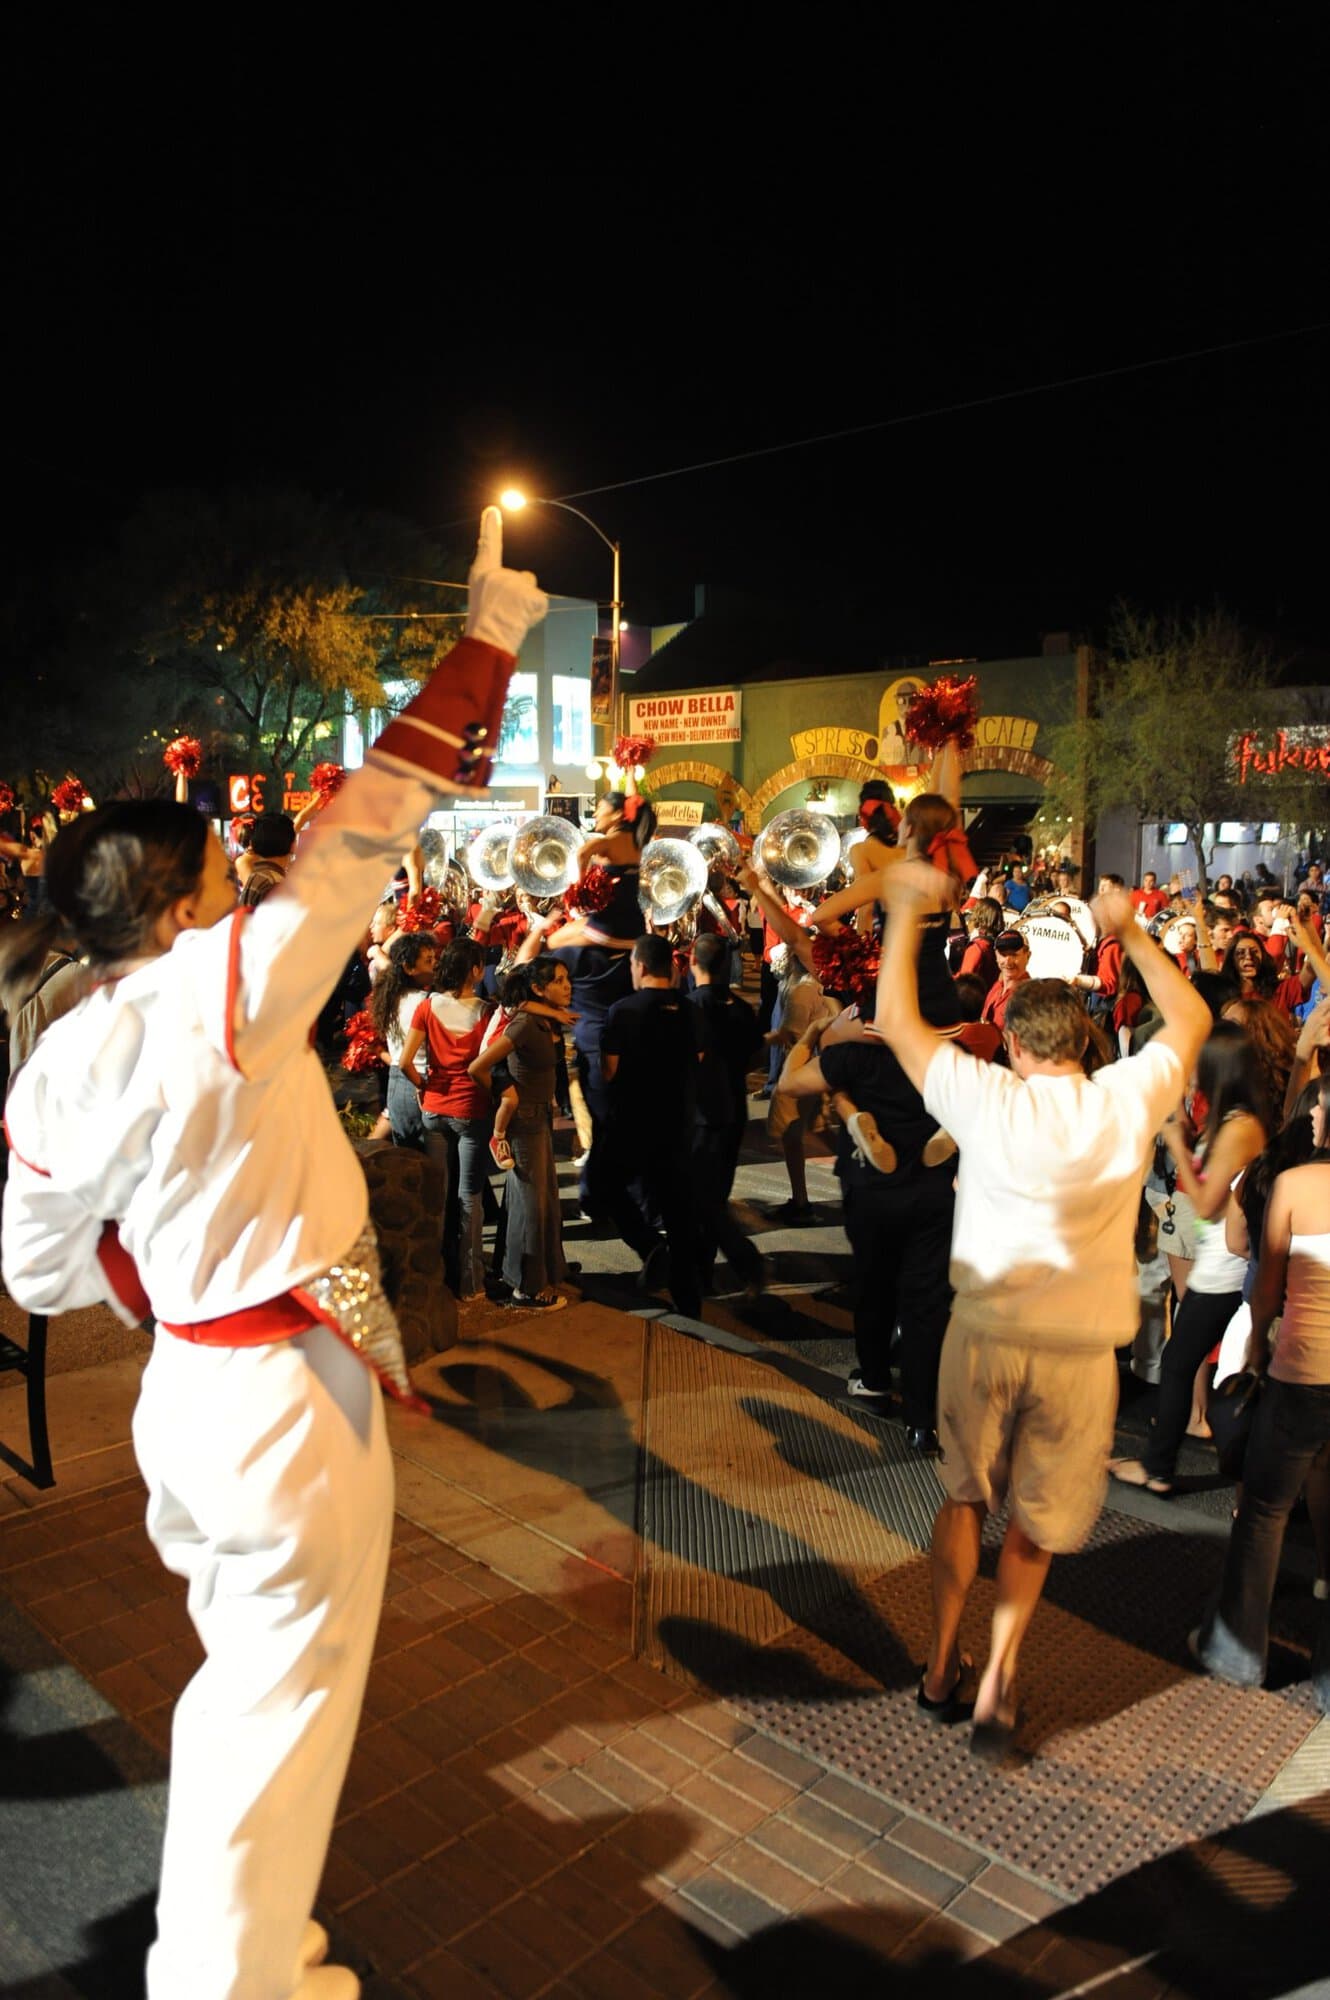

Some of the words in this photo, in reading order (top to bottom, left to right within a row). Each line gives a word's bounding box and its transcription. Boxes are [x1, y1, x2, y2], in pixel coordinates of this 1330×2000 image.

[636, 699, 684, 718] CHOW
[688, 695, 735, 714] BELLA
[643, 719, 659, 730] NEW
[660, 718, 679, 729] NAME
[683, 717, 700, 728] NEW
[700, 715, 727, 727] OWNER
[689, 729, 715, 740] DELIVERY
[716, 727, 740, 739] SERVICE
[1032, 926, 1071, 942] YAMAHA
